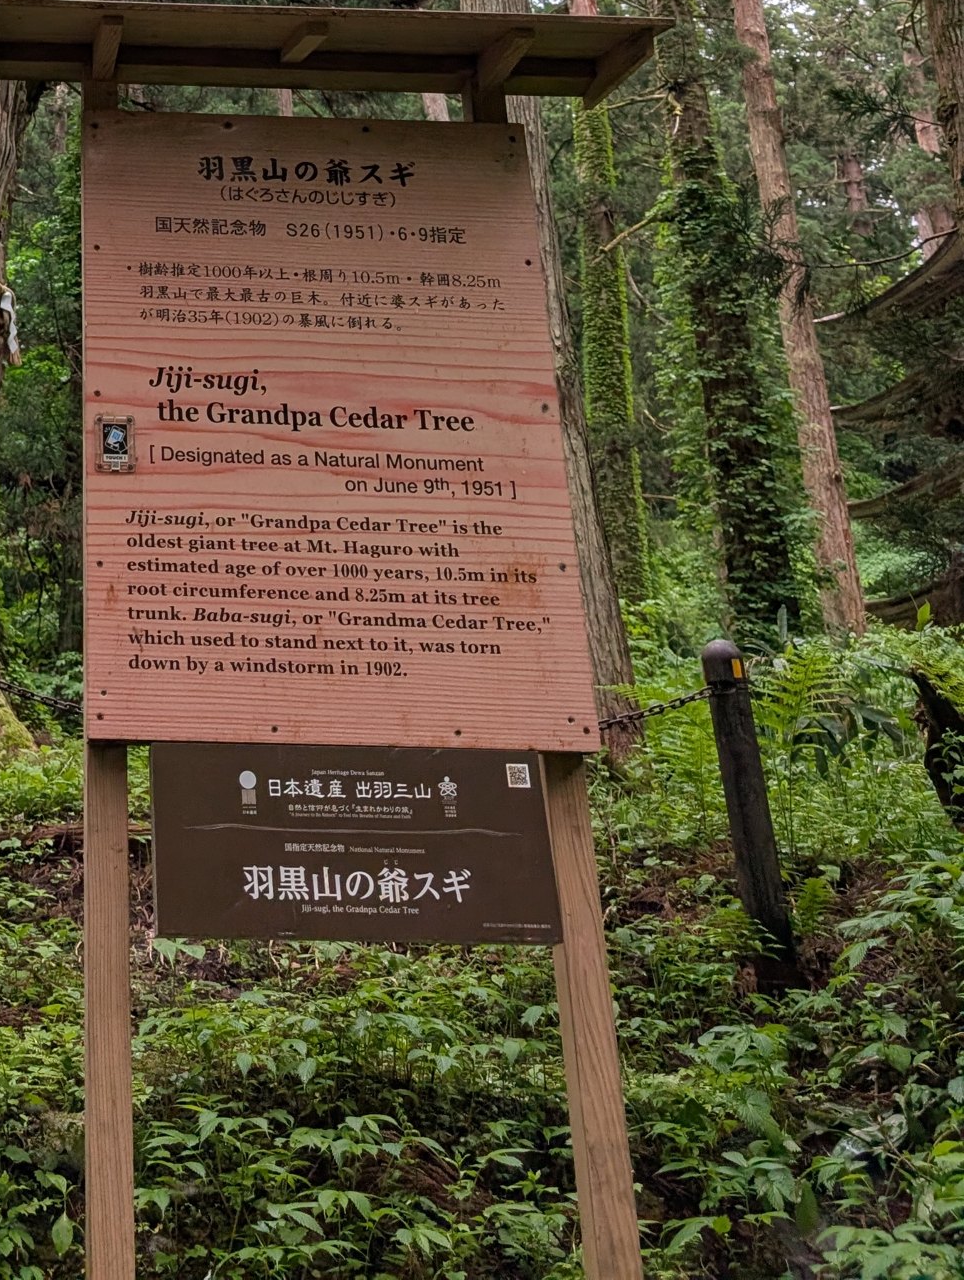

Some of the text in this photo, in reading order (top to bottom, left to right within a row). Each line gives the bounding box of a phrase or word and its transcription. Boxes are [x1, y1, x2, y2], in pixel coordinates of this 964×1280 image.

[198, 156, 416, 187] 羽黒山の爺スギ
[220, 185, 396, 208] (はぐろさんのじじすぎ)
[155, 216, 266, 237] 国天然記念物
[149, 365, 267, 396] Jiji-sugi,
[156, 399, 475, 431] the Grandpa Cedar Tree
[161, 446, 264, 466] Designated
[271, 453, 292, 466] as
[297, 454, 309, 466] a
[315, 451, 380, 469] Natural
[386, 453, 484, 472] Monument
[345, 479, 367, 493] on
[374, 477, 418, 494] June
[424, 477, 456, 498] 9th,
[461, 481, 503, 497] 1951
[125, 510, 503, 536] Jiji-sugi, or "Grandpa Cedar Tree" is the
[127, 533, 460, 559] oldest giant tree at Mt. Haguro with
[127, 557, 537, 584] estimated age of over 1000 years, 10.5m in its
[127, 582, 500, 606] root circumference and 8.25m at its tree
[127, 606, 550, 634] trunk. Baba-sugi, or "Grandma Cedar Tree,"
[128, 629, 501, 655] which used to stand next to it, was torn
[128, 654, 408, 677] down by a windstorm in 1902.
[311, 768, 327, 776] Japan
[327, 769, 349, 777] Heritage
[268, 778, 431, 799] 日本遺産 出羽三山
[285, 843, 345, 853] 国指定天然記念物
[243, 865, 472, 904] 羽黒山の爺スギ
[301, 904, 330, 913] Jiji-sugi,
[332, 904, 344, 912] the
[379, 906, 400, 914] Cedar
[402, 906, 420, 915] Tree
